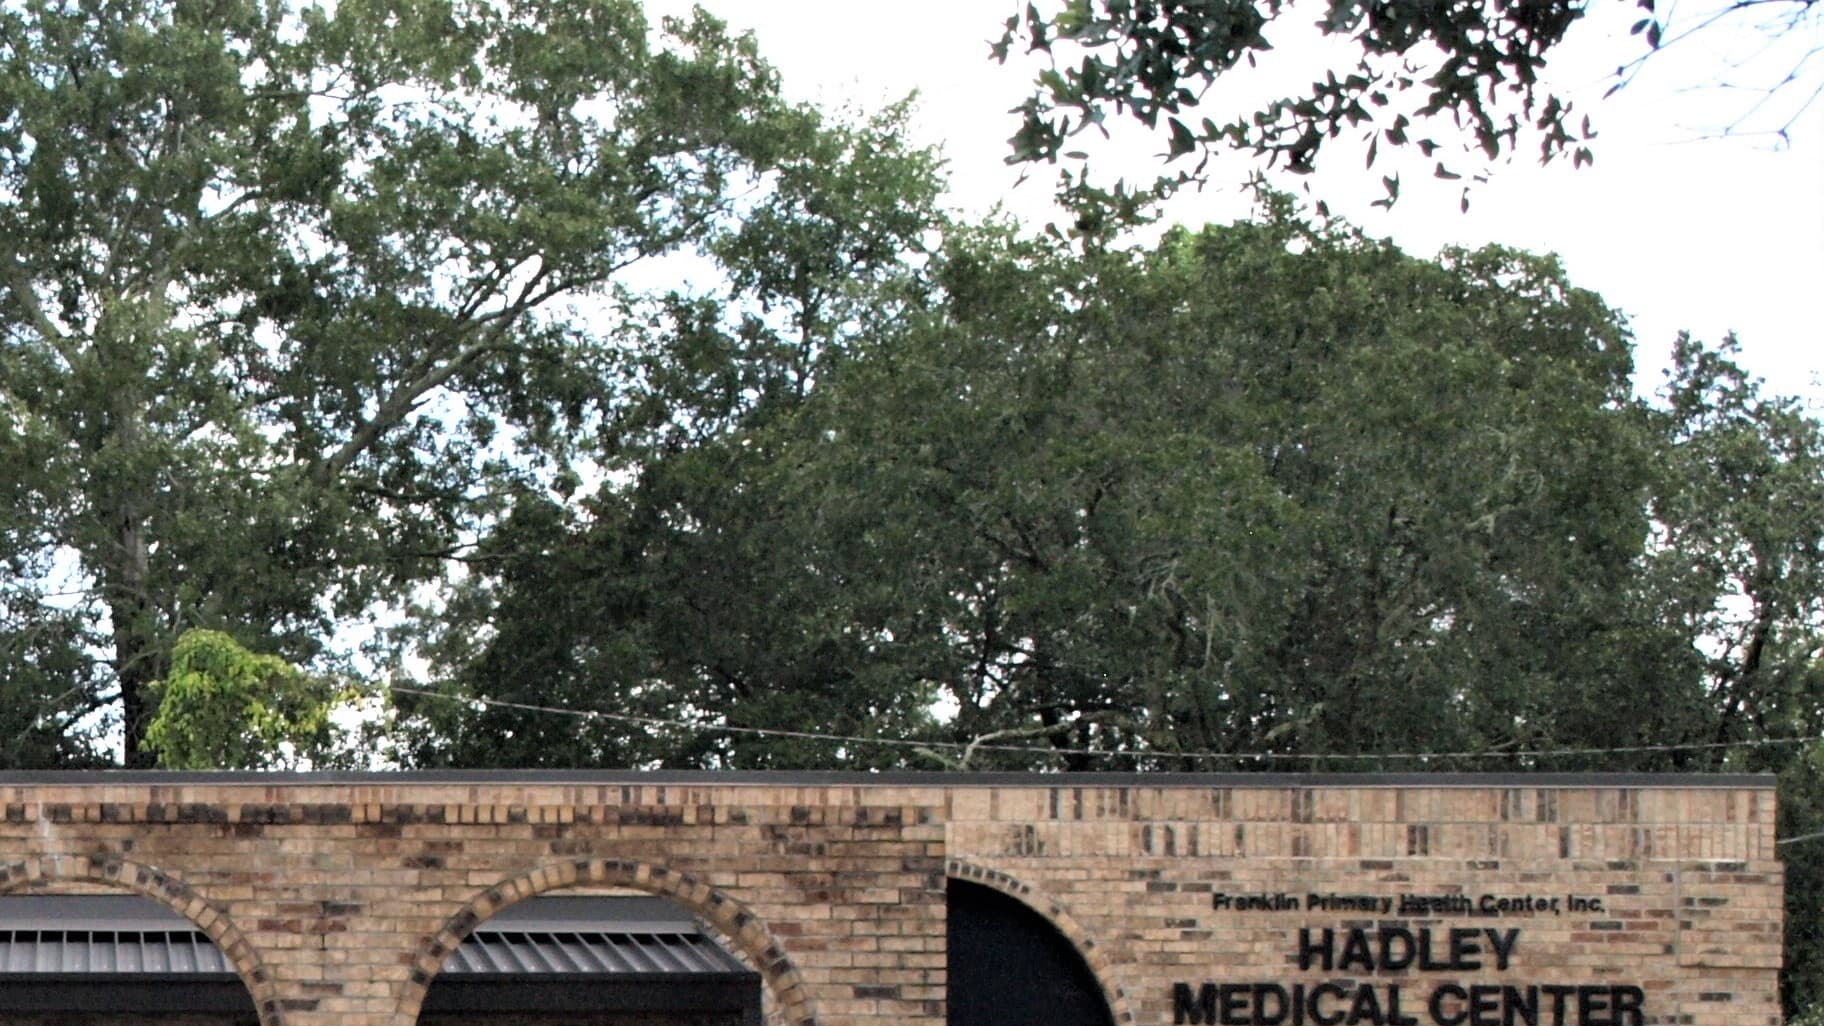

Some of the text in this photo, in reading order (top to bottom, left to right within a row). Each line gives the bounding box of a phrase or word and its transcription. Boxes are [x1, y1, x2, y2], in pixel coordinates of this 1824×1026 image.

[1212, 892, 1606, 915] Franklin Primary Health Center, Inc.
[1297, 927, 1520, 971] HADLEY
[1172, 982, 1418, 1026] MEDICAL
